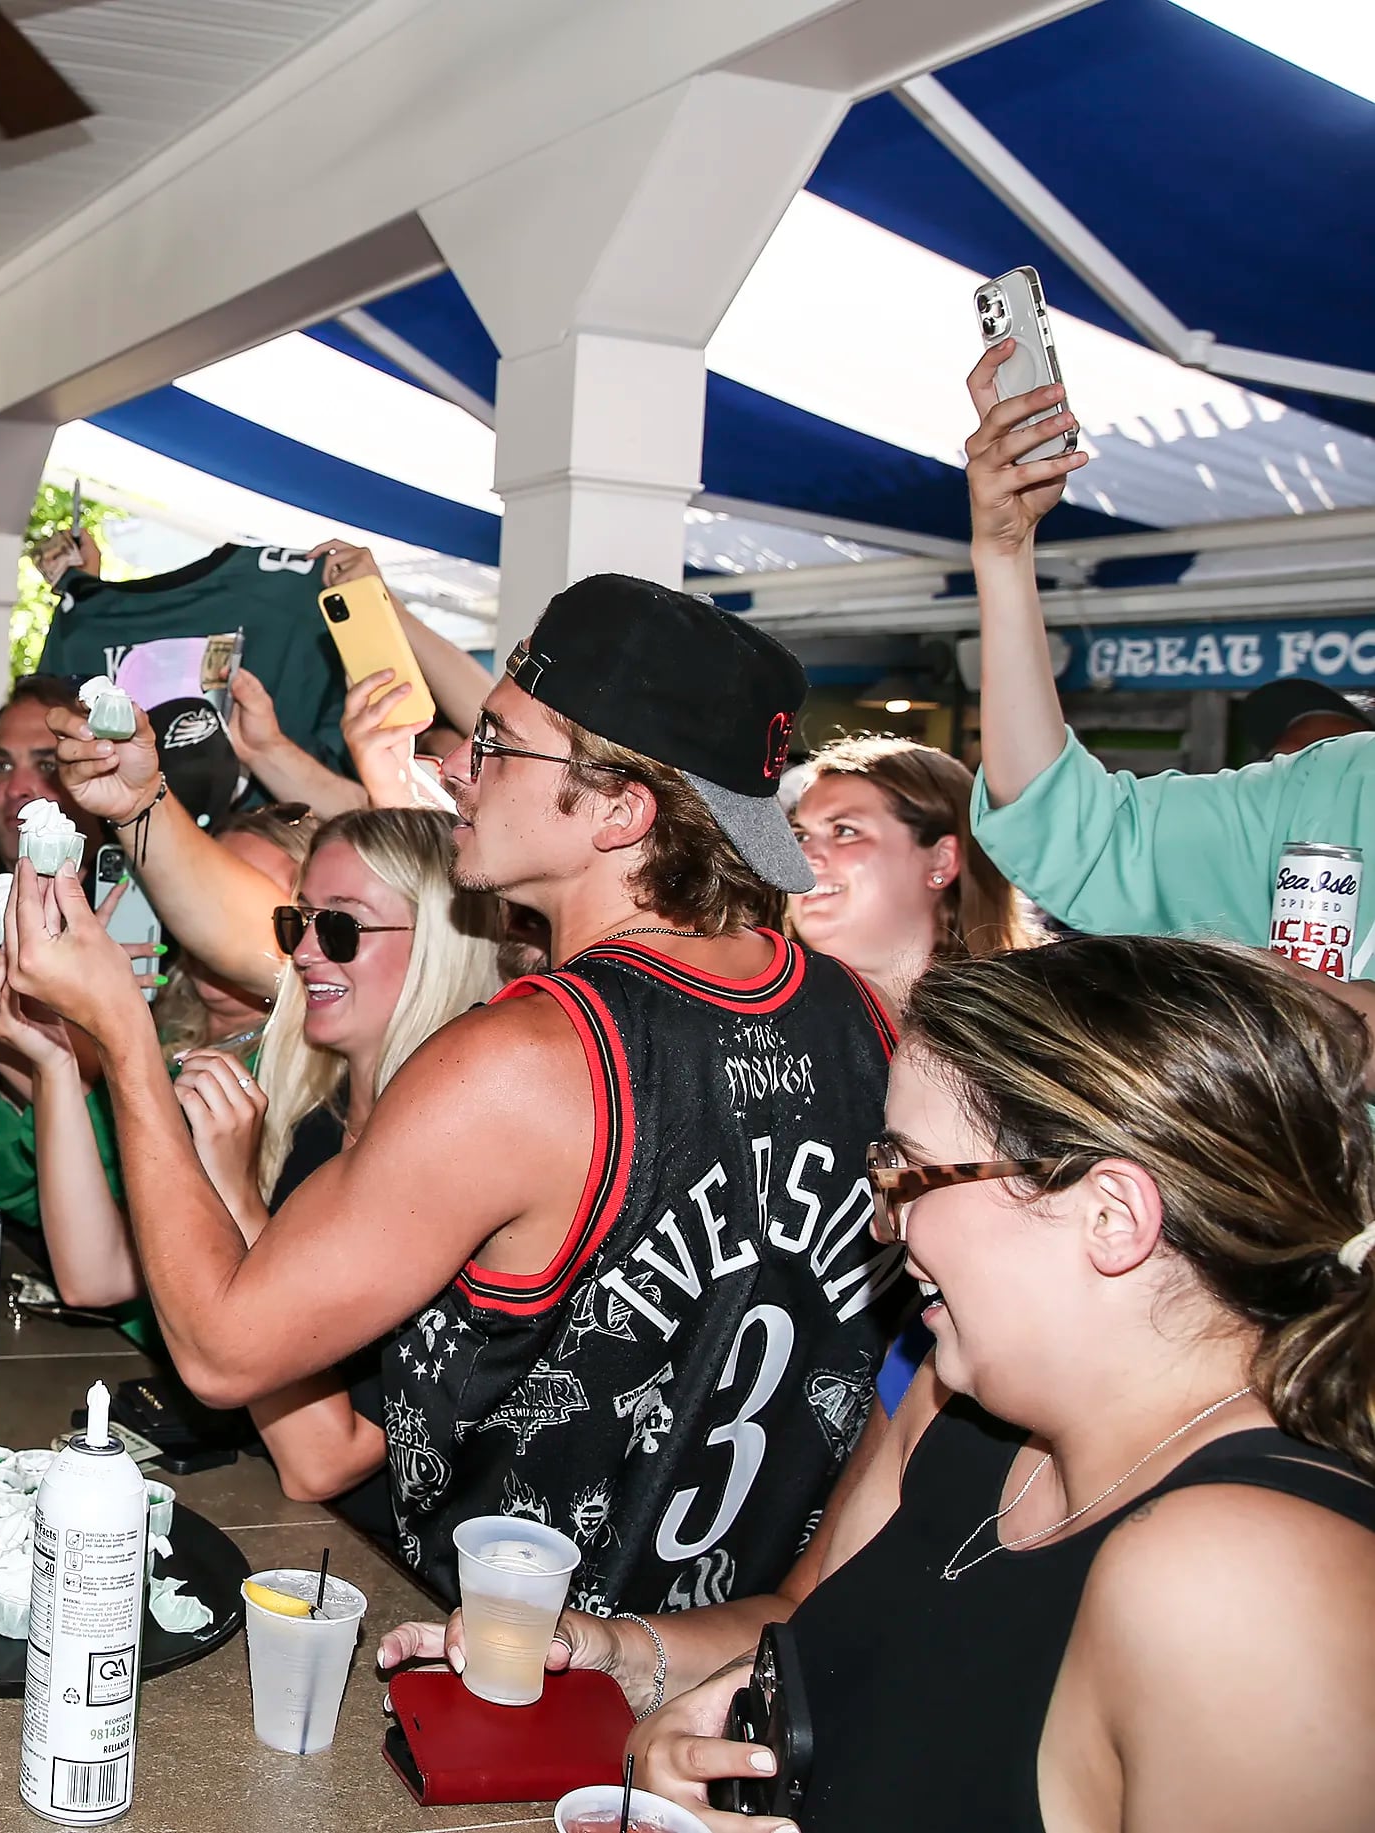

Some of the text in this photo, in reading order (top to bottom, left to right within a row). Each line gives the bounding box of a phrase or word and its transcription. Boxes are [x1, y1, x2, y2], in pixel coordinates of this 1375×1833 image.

[1089, 635, 1262, 679] GREAT
[1277, 867, 1356, 896] Sea Isle
[1271, 918, 1351, 947] ICED
[741, 1024, 777, 1051] THE
[390, 1425, 423, 1448] 2001
[656, 1303, 795, 1563] 3
[45, 1560, 55, 1574] 20
[90, 1721, 130, 1740] 9814583
[103, 1737, 130, 1754] RELIANCE
